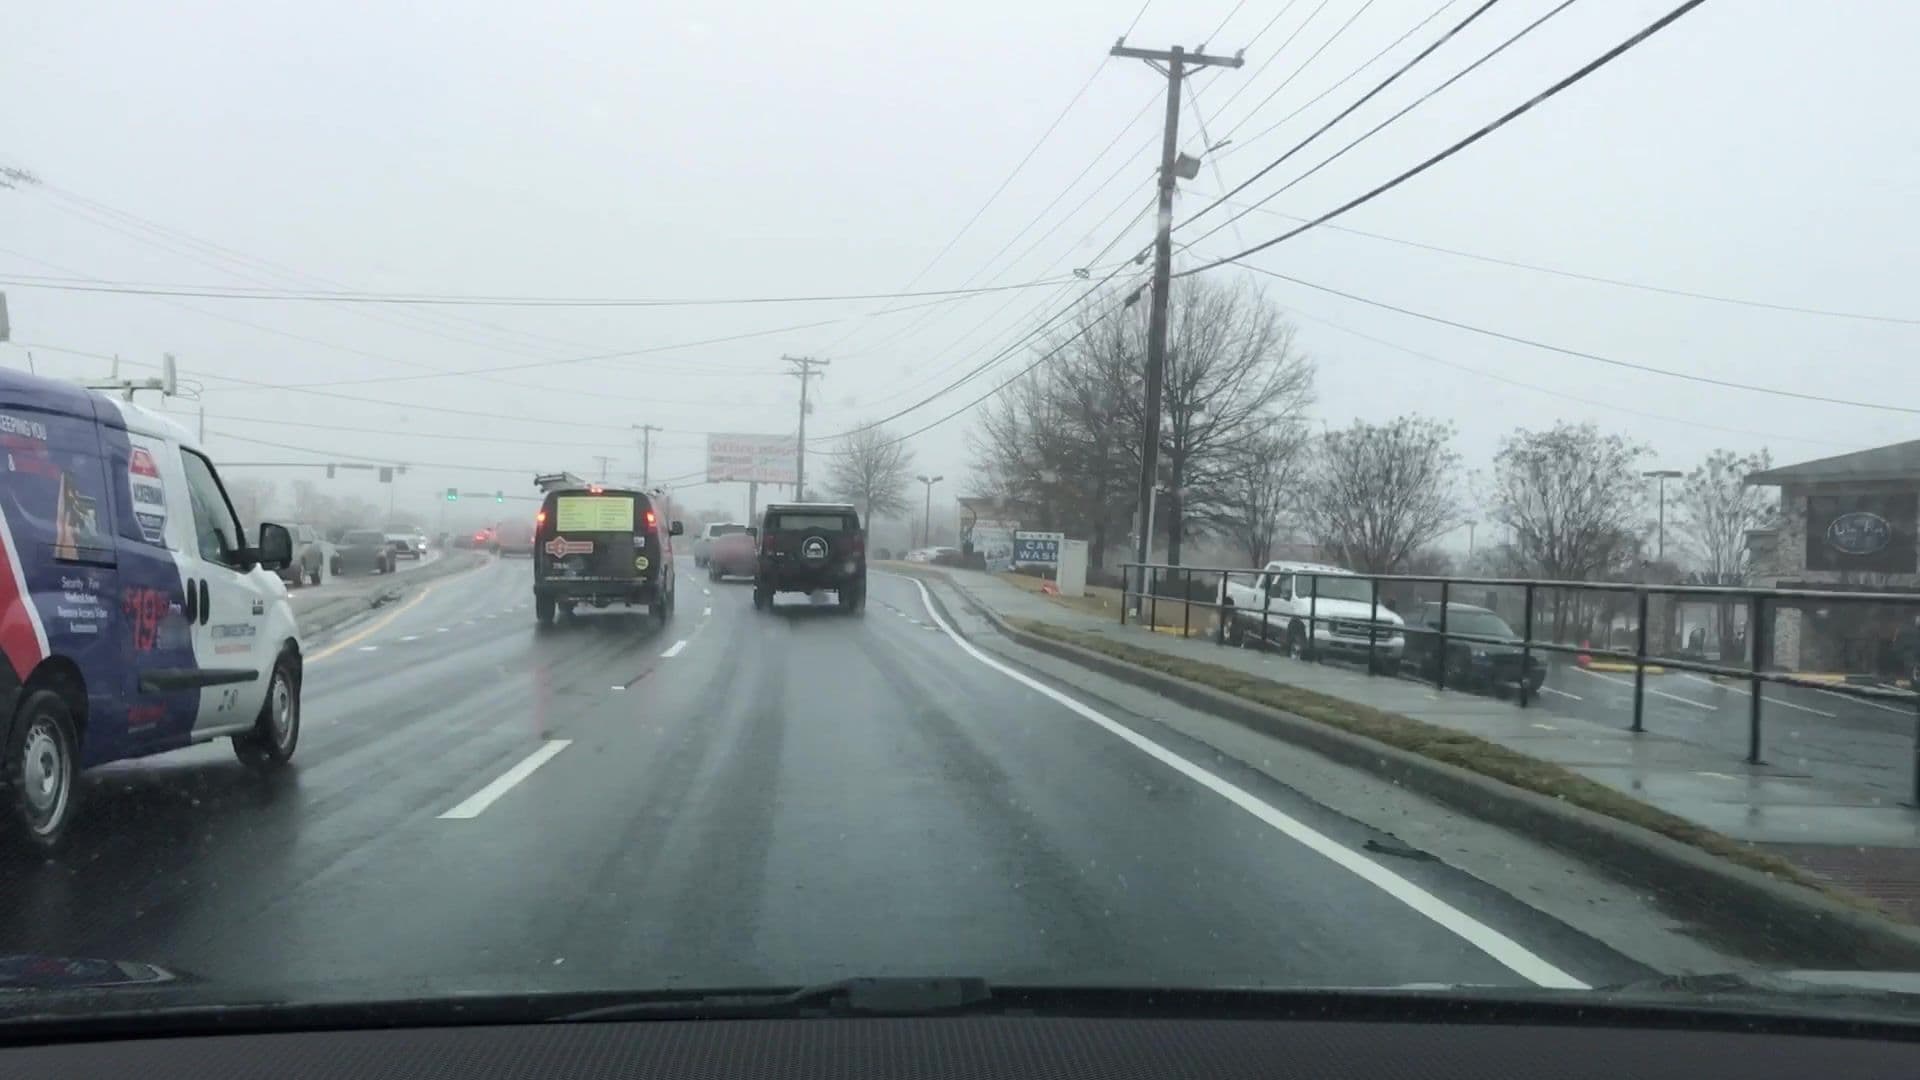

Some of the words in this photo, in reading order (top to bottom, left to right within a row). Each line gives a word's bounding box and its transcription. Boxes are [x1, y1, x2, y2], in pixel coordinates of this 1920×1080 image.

[31, 420, 47, 440] YOU
[1025, 541, 1055, 550] CAR
[1020, 550, 1058, 560] WASH
